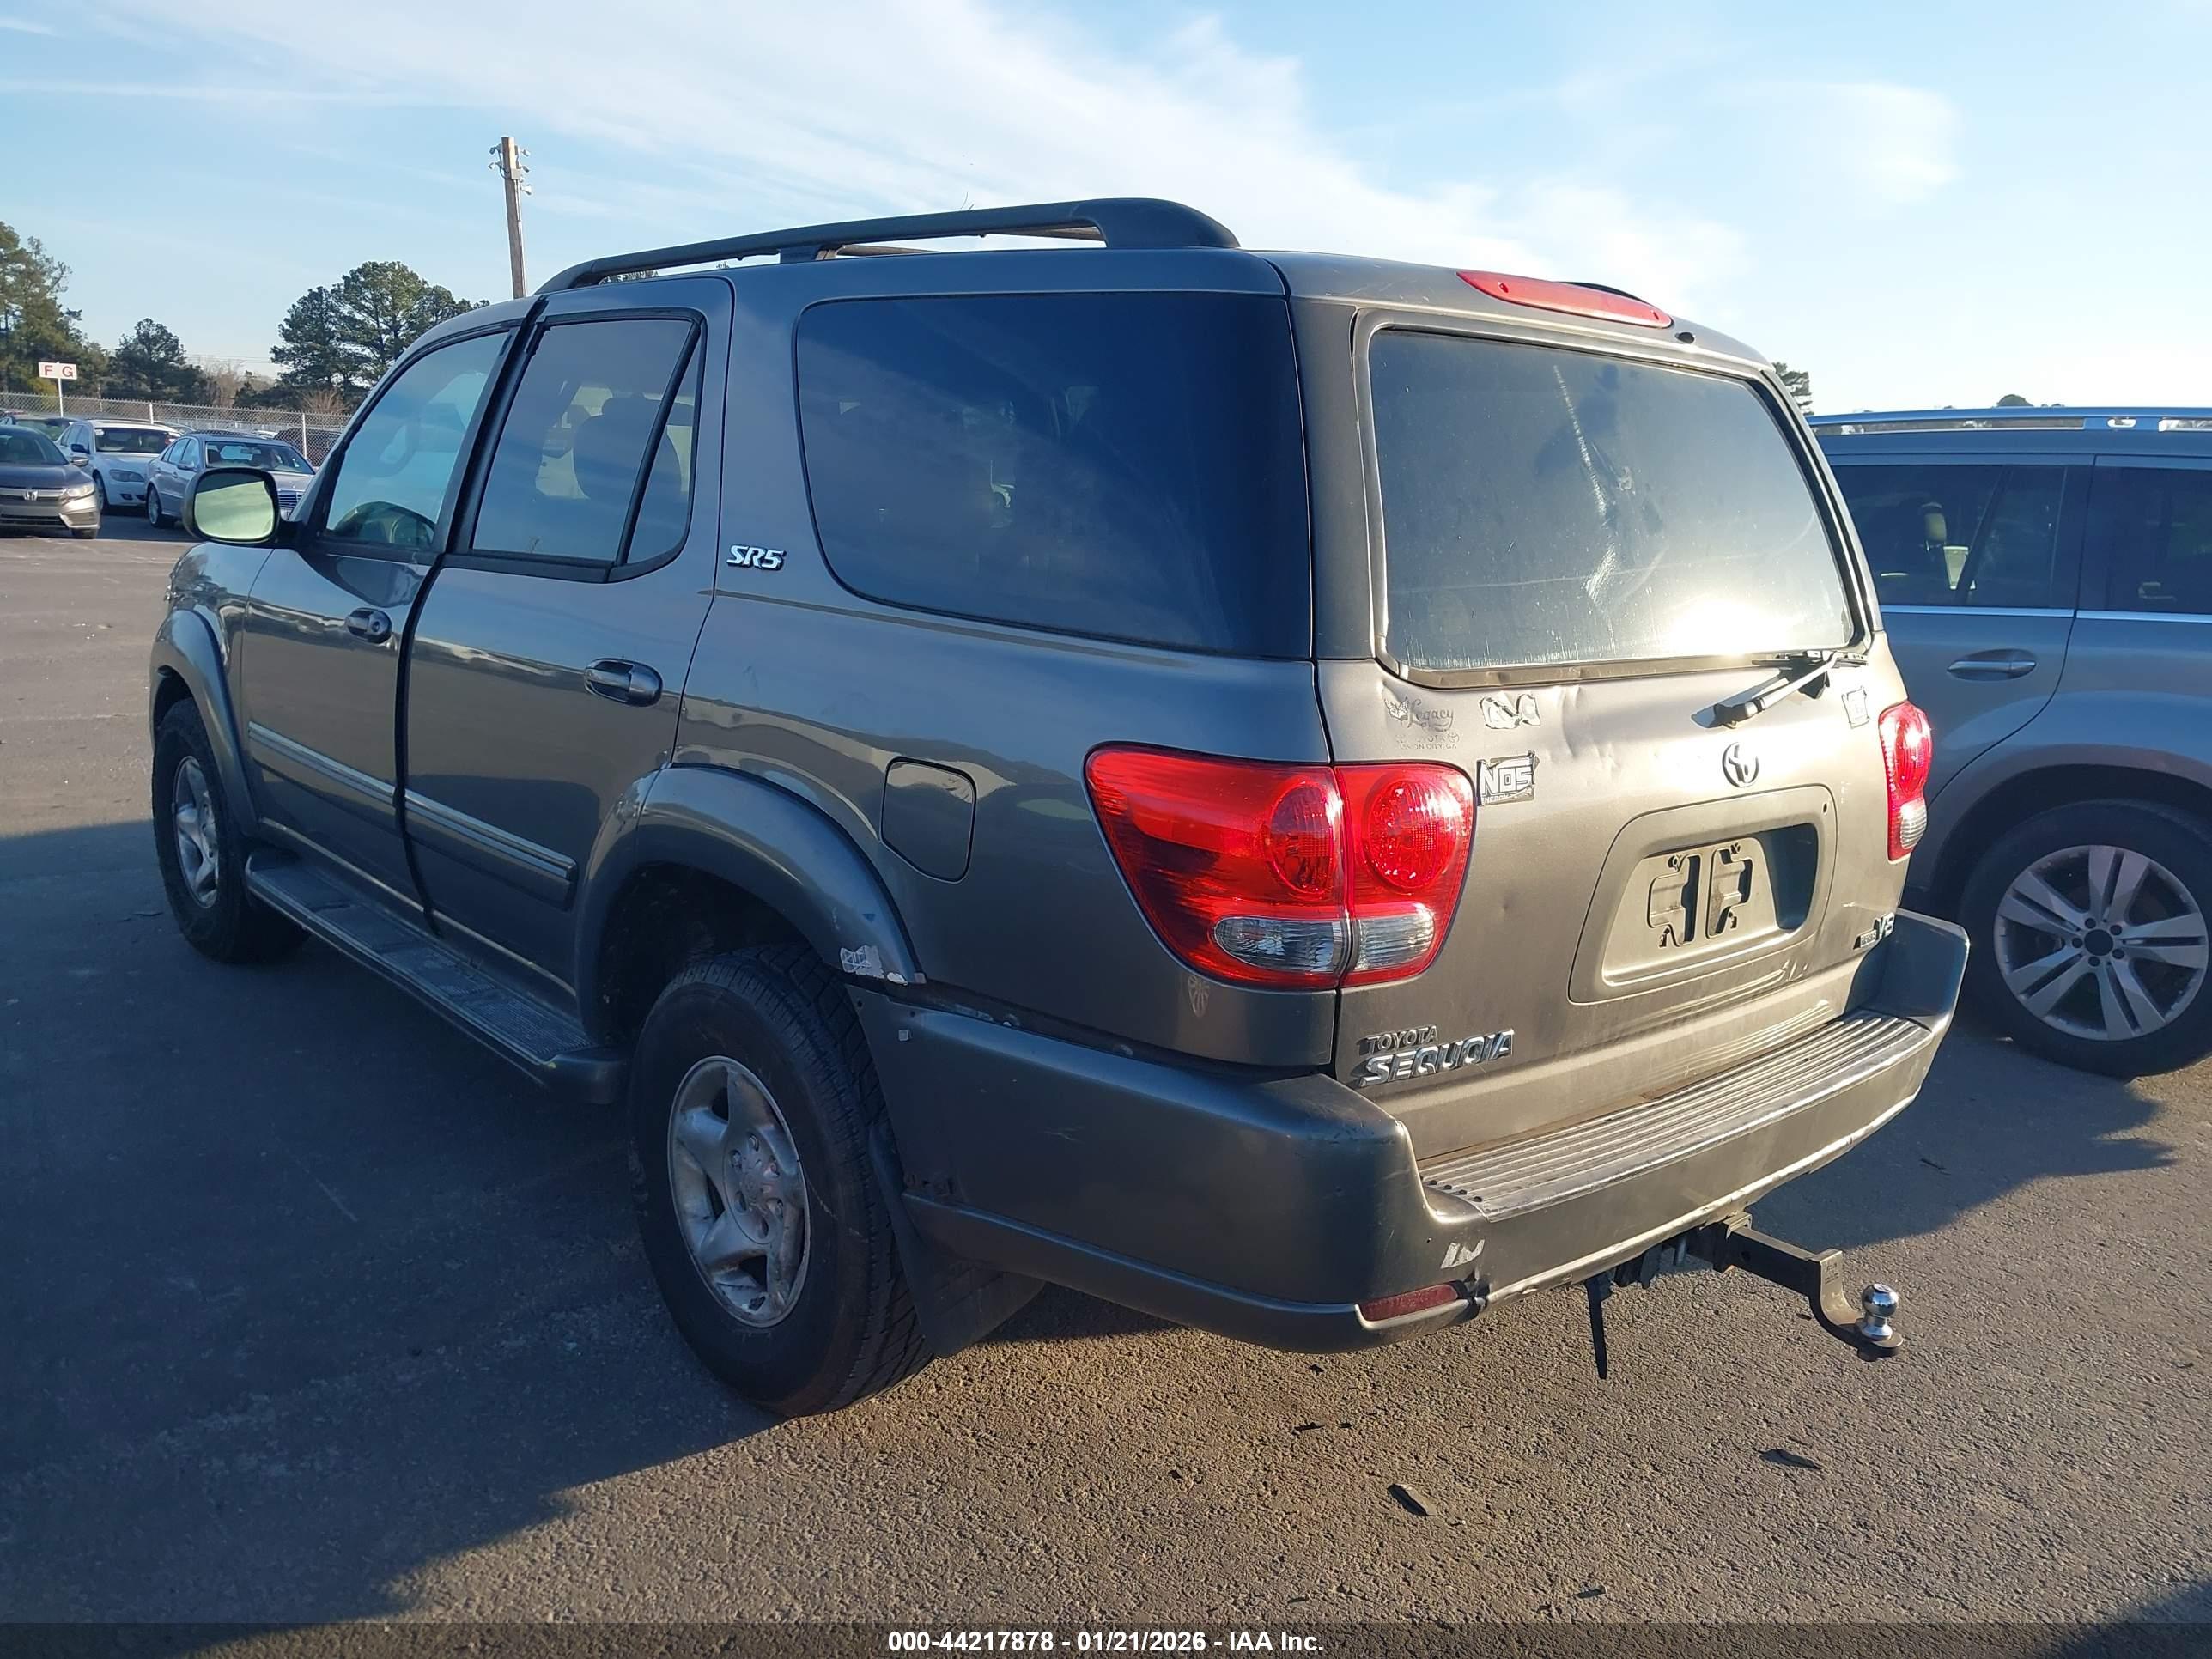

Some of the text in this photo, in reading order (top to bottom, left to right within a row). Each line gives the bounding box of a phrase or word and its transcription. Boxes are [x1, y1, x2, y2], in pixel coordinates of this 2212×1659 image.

[45, 365, 74, 378] F G
[726, 544, 785, 570] SR5
[1479, 761, 1533, 797] NOS
[1875, 912, 1895, 940] V8
[1364, 1024, 1439, 1055] TOYOTA
[1356, 1029, 1515, 1088] SEQUOIA
